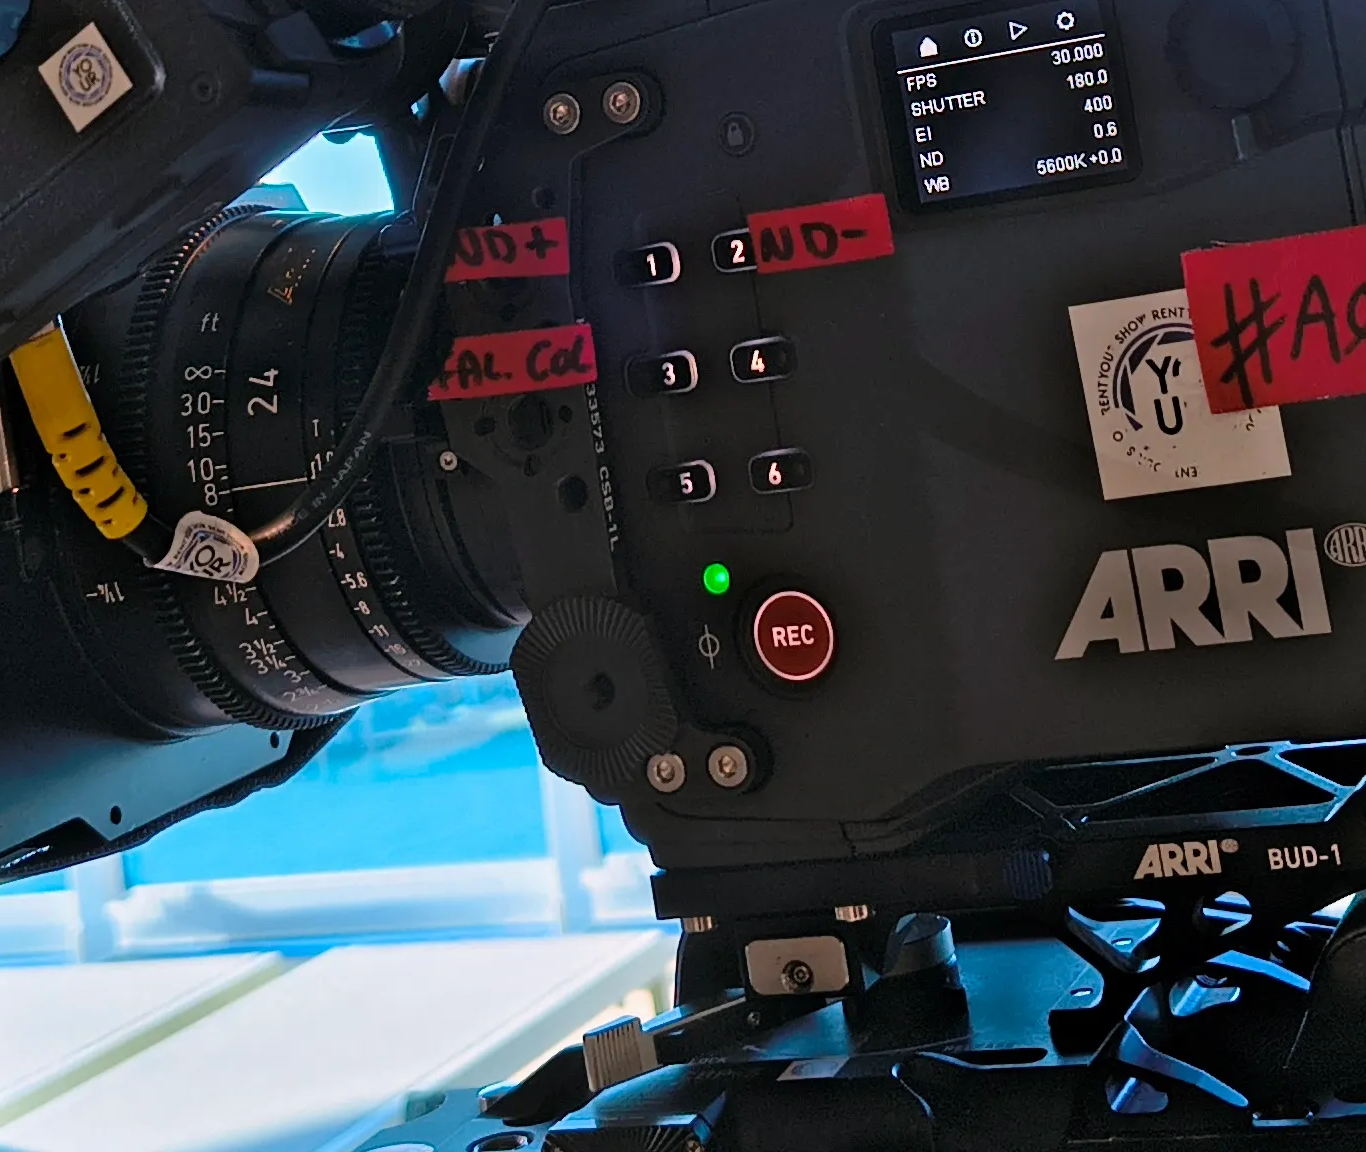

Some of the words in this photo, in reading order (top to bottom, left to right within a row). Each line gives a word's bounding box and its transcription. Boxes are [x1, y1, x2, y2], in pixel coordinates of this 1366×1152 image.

[906, 73, 937, 92] FPS
[1051, 43, 1104, 66] 30.000
[911, 91, 986, 117] SHUTTER
[1066, 69, 1108, 90] 180.0
[915, 126, 932, 142] EI
[1084, 95, 1112, 113] 400
[919, 151, 944, 169] ND
[1093, 122, 1117, 139] 0.6
[924, 176, 950, 194] WB
[1037, 153, 1087, 176] 5600K
[1089, 148, 1123, 165] +0.0
[730, 240, 745, 263] 2
[646, 253, 657, 276] 1
[201, 312, 219, 332] ft
[1151, 307, 1192, 321] RENT
[750, 349, 765, 373] 4
[661, 362, 676, 386] 3
[181, 392, 211, 417] 30
[247, 368, 278, 417] 24
[586, 384, 605, 454] 33573
[187, 423, 211, 449] 15
[187, 457, 213, 483] 10
[768, 461, 782, 485] 6
[204, 483, 218, 506] 8
[679, 472, 693, 494] 5
[346, 572, 368, 590] 5.6
[1054, 527, 1332, 660] ARRI
[245, 608, 259, 626] 4
[772, 624, 814, 647] REC
[284, 670, 302, 684] 3
[1134, 840, 1222, 880] ARRI
[1268, 844, 1342, 870] BUD-1
